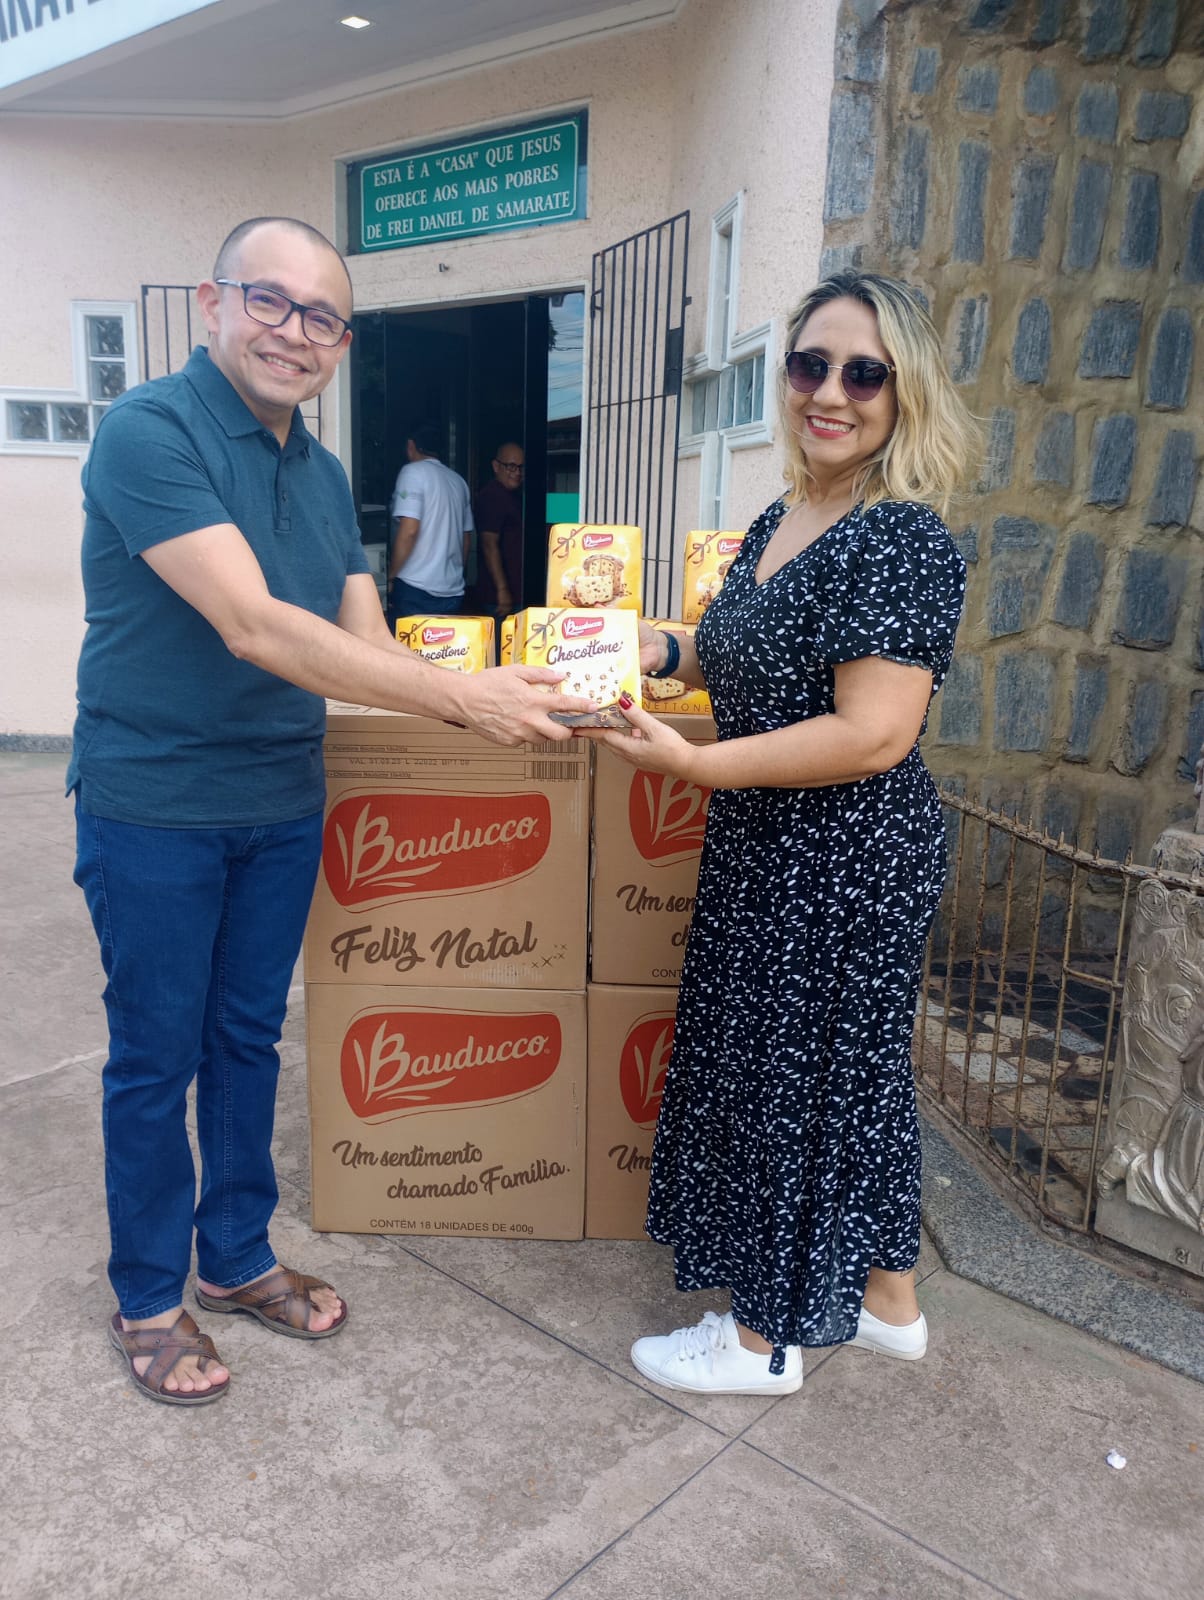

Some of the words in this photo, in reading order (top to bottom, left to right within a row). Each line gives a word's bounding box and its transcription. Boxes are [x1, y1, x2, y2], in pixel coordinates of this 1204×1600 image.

[374, 168, 402, 187] ESTA
[407, 161, 415, 180] É
[420, 162, 430, 178] A
[485, 144, 514, 168] QUE
[521, 133, 561, 162] JESUS
[375, 189, 427, 212] OFERECE
[433, 184, 458, 203] AOS
[465, 176, 498, 197] MAIS
[505, 163, 559, 190] POBRES
[367, 224, 382, 240] DE
[387, 219, 413, 237] FREI
[419, 210, 465, 231] DANIEL
[472, 205, 489, 223] DE
[496, 191, 570, 219] SAMARATE
[546, 639, 623, 665] Chocottone
[643, 701, 711, 713] NETTONE
[335, 802, 539, 892] Bauducco
[616, 884, 664, 915] Um
[330, 924, 426, 973] Feliz
[430, 920, 538, 968] Natal
[652, 968, 682, 978] CONT
[353, 1020, 550, 1104] Bauducco
[332, 1140, 378, 1168] Um
[380, 1141, 482, 1168] sentimento
[387, 1177, 478, 1199] chamado
[420, 1221, 431, 1230] 18
[434, 1221, 489, 1232] UNIDADES
[492, 1223, 507, 1232] DE
[509, 1224, 534, 1234] 400g
